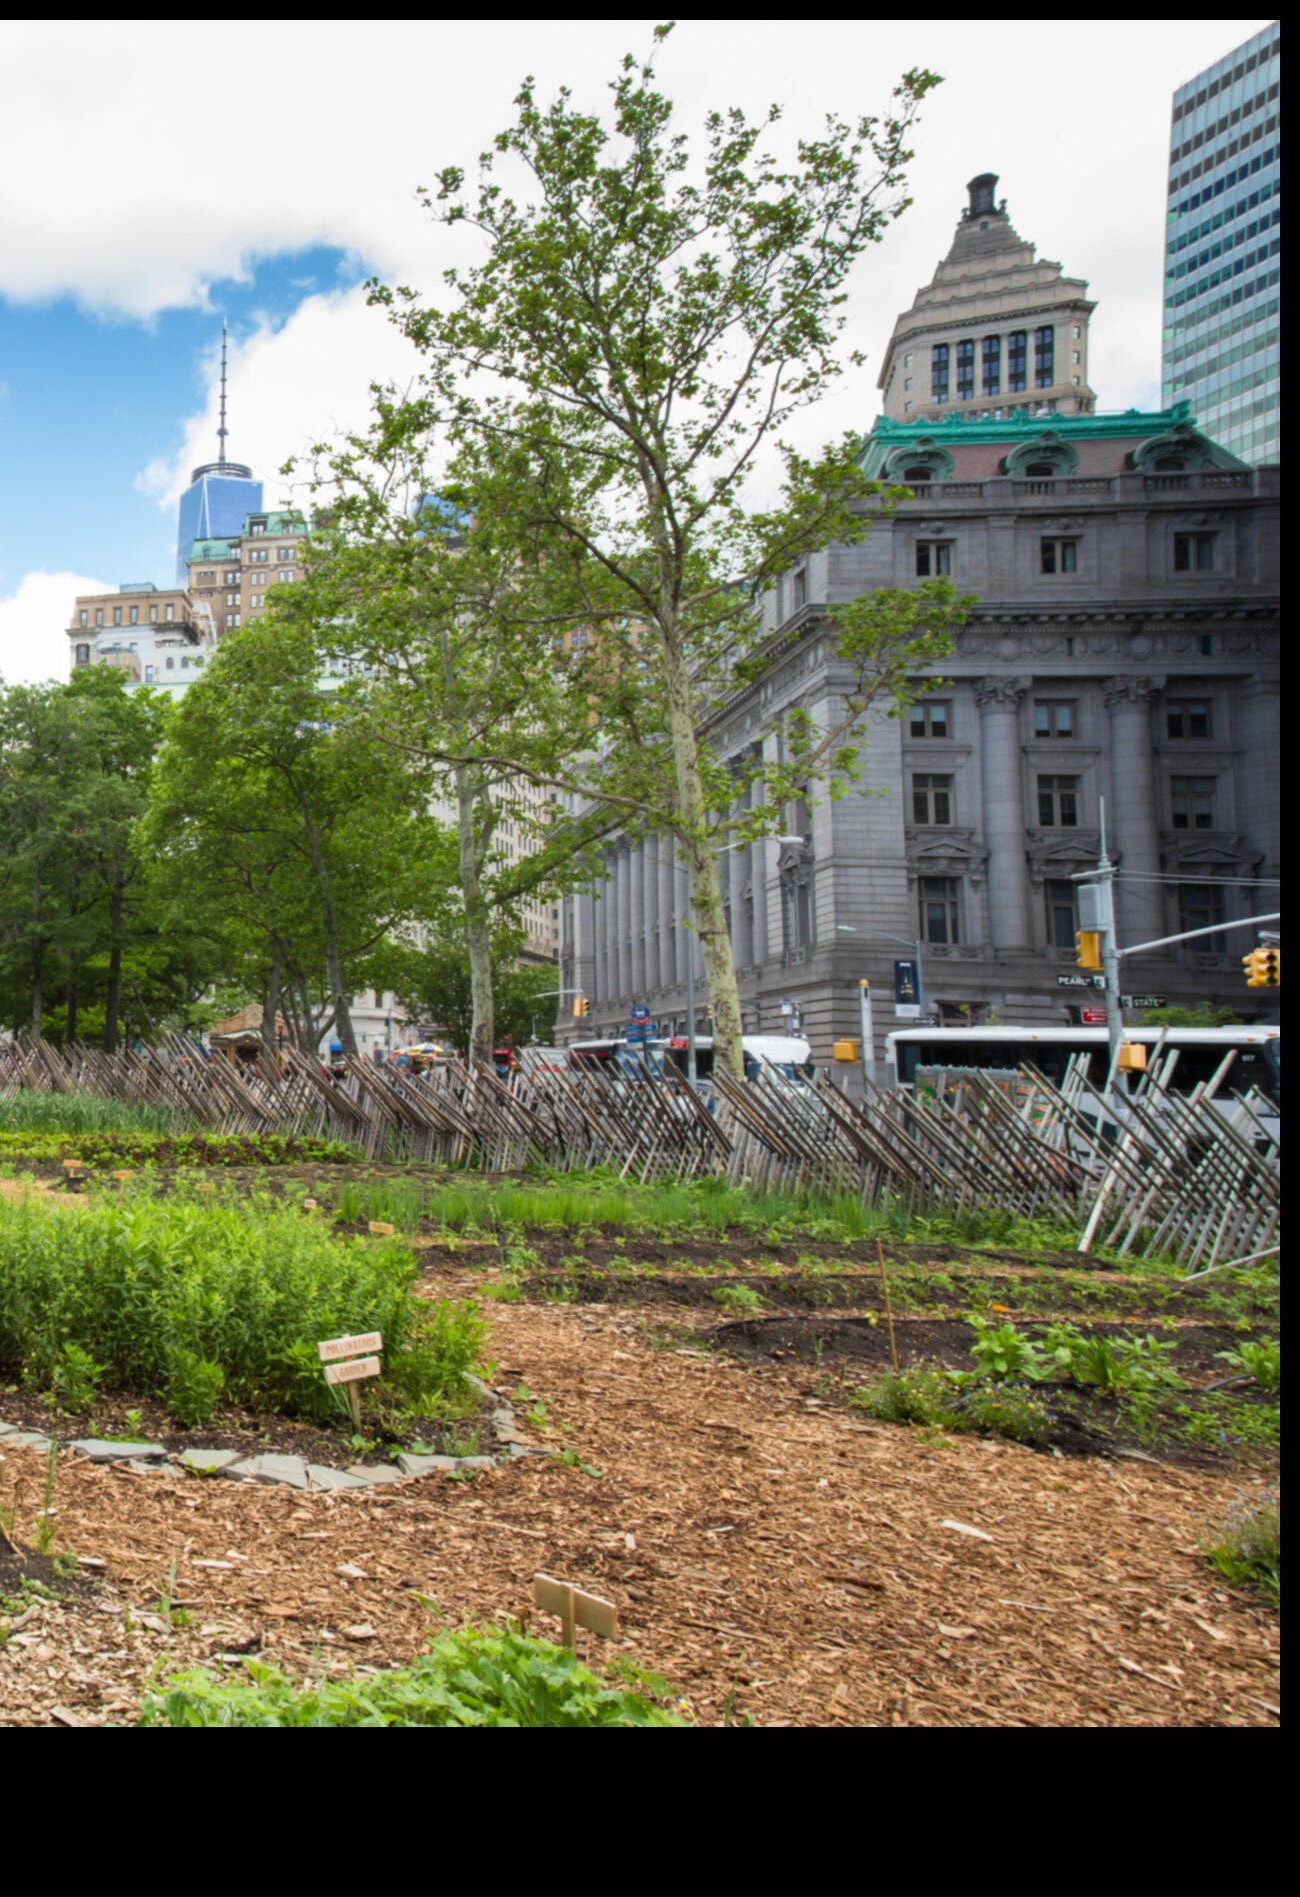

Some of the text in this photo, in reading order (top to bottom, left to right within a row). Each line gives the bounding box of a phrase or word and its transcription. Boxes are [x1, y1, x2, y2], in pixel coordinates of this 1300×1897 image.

[1058, 976, 1087, 986] PEARL
[1133, 998, 1159, 1007] STATE
[326, 1336, 377, 1355] POLLINATORS
[340, 1363, 367, 1378] GARDEN
